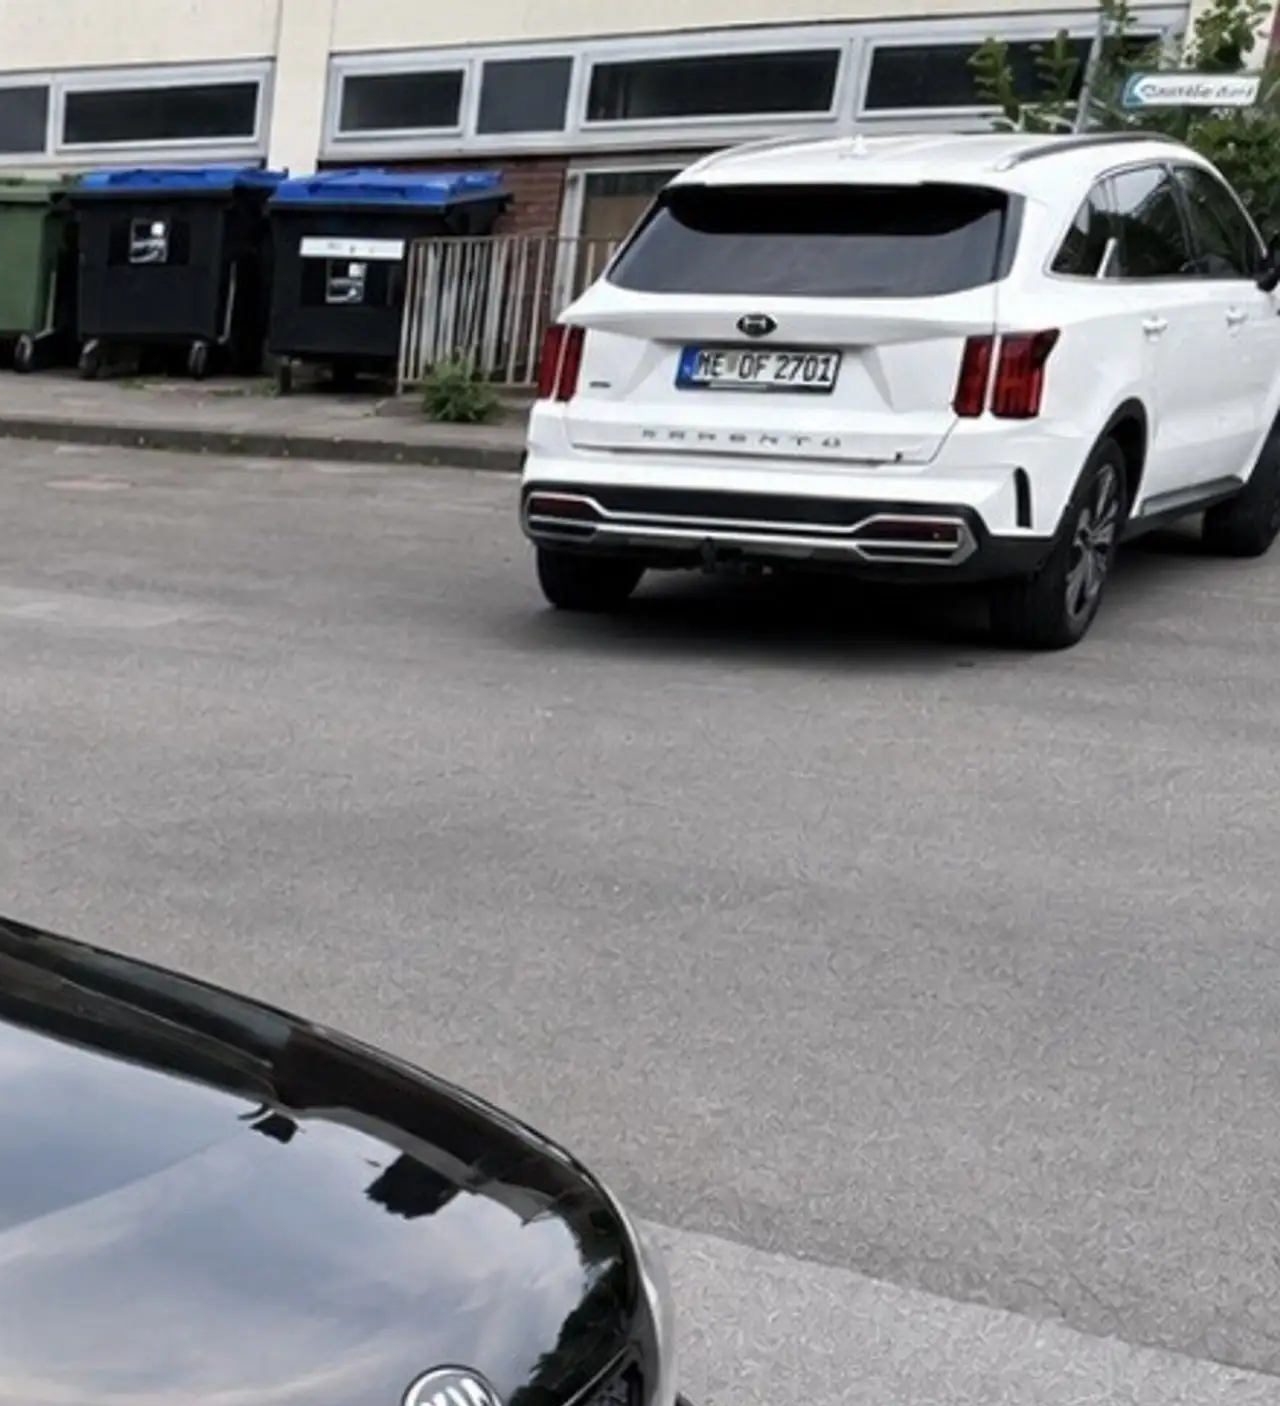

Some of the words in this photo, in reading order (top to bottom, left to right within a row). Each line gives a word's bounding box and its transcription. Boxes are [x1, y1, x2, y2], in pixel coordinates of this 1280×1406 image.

[698, 352, 726, 377] ME
[739, 353, 772, 379] OF
[774, 355, 831, 383] 2701
